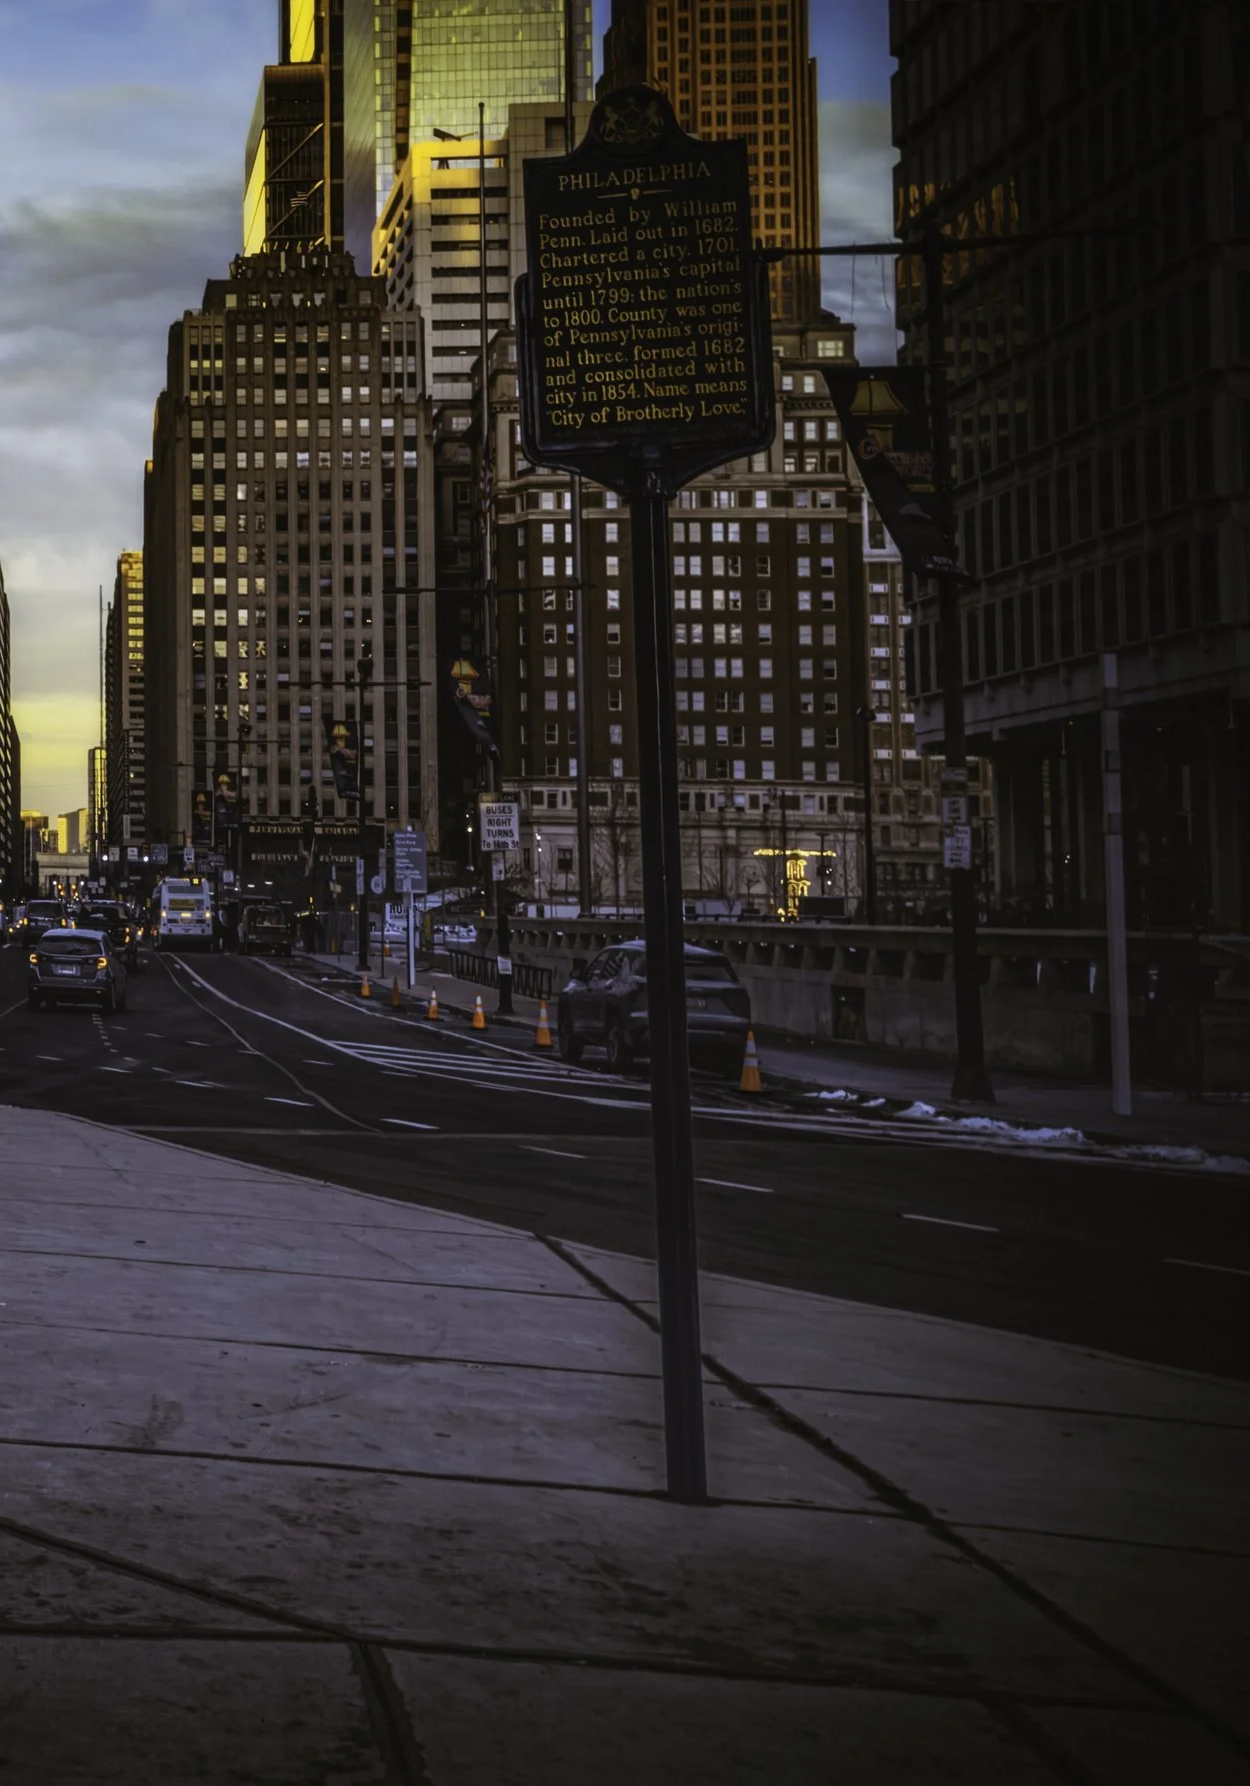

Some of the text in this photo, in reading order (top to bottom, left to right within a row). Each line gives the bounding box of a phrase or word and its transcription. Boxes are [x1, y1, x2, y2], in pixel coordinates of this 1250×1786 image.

[559, 161, 710, 190] PHILADELPHIA
[539, 200, 737, 229] Founded by William
[540, 217, 738, 249] Penn. Laid out in 1682.
[540, 248, 629, 268] Chartered
[637, 249, 645, 260] a
[698, 237, 739, 255] 1701.
[542, 256, 740, 288] Pennsylvania's capital
[543, 292, 582, 309] until
[640, 285, 666, 301] the
[676, 280, 741, 298] nation's
[544, 302, 742, 328] to 1800. County was one
[544, 317, 742, 346] of Pennsylvania's origi-
[546, 351, 570, 368] nal
[634, 341, 697, 360] formed
[704, 337, 745, 355] 1682
[546, 357, 745, 386] and consolidated with
[546, 379, 747, 408] city in 1854. Name means
[591, 407, 609, 423] of
[617, 402, 694, 422] Brotherly
[486, 806, 513, 815] BUSES
[487, 818, 512, 827] RIGHT
[482, 840, 491, 849] To
[486, 829, 515, 838] TURNS
